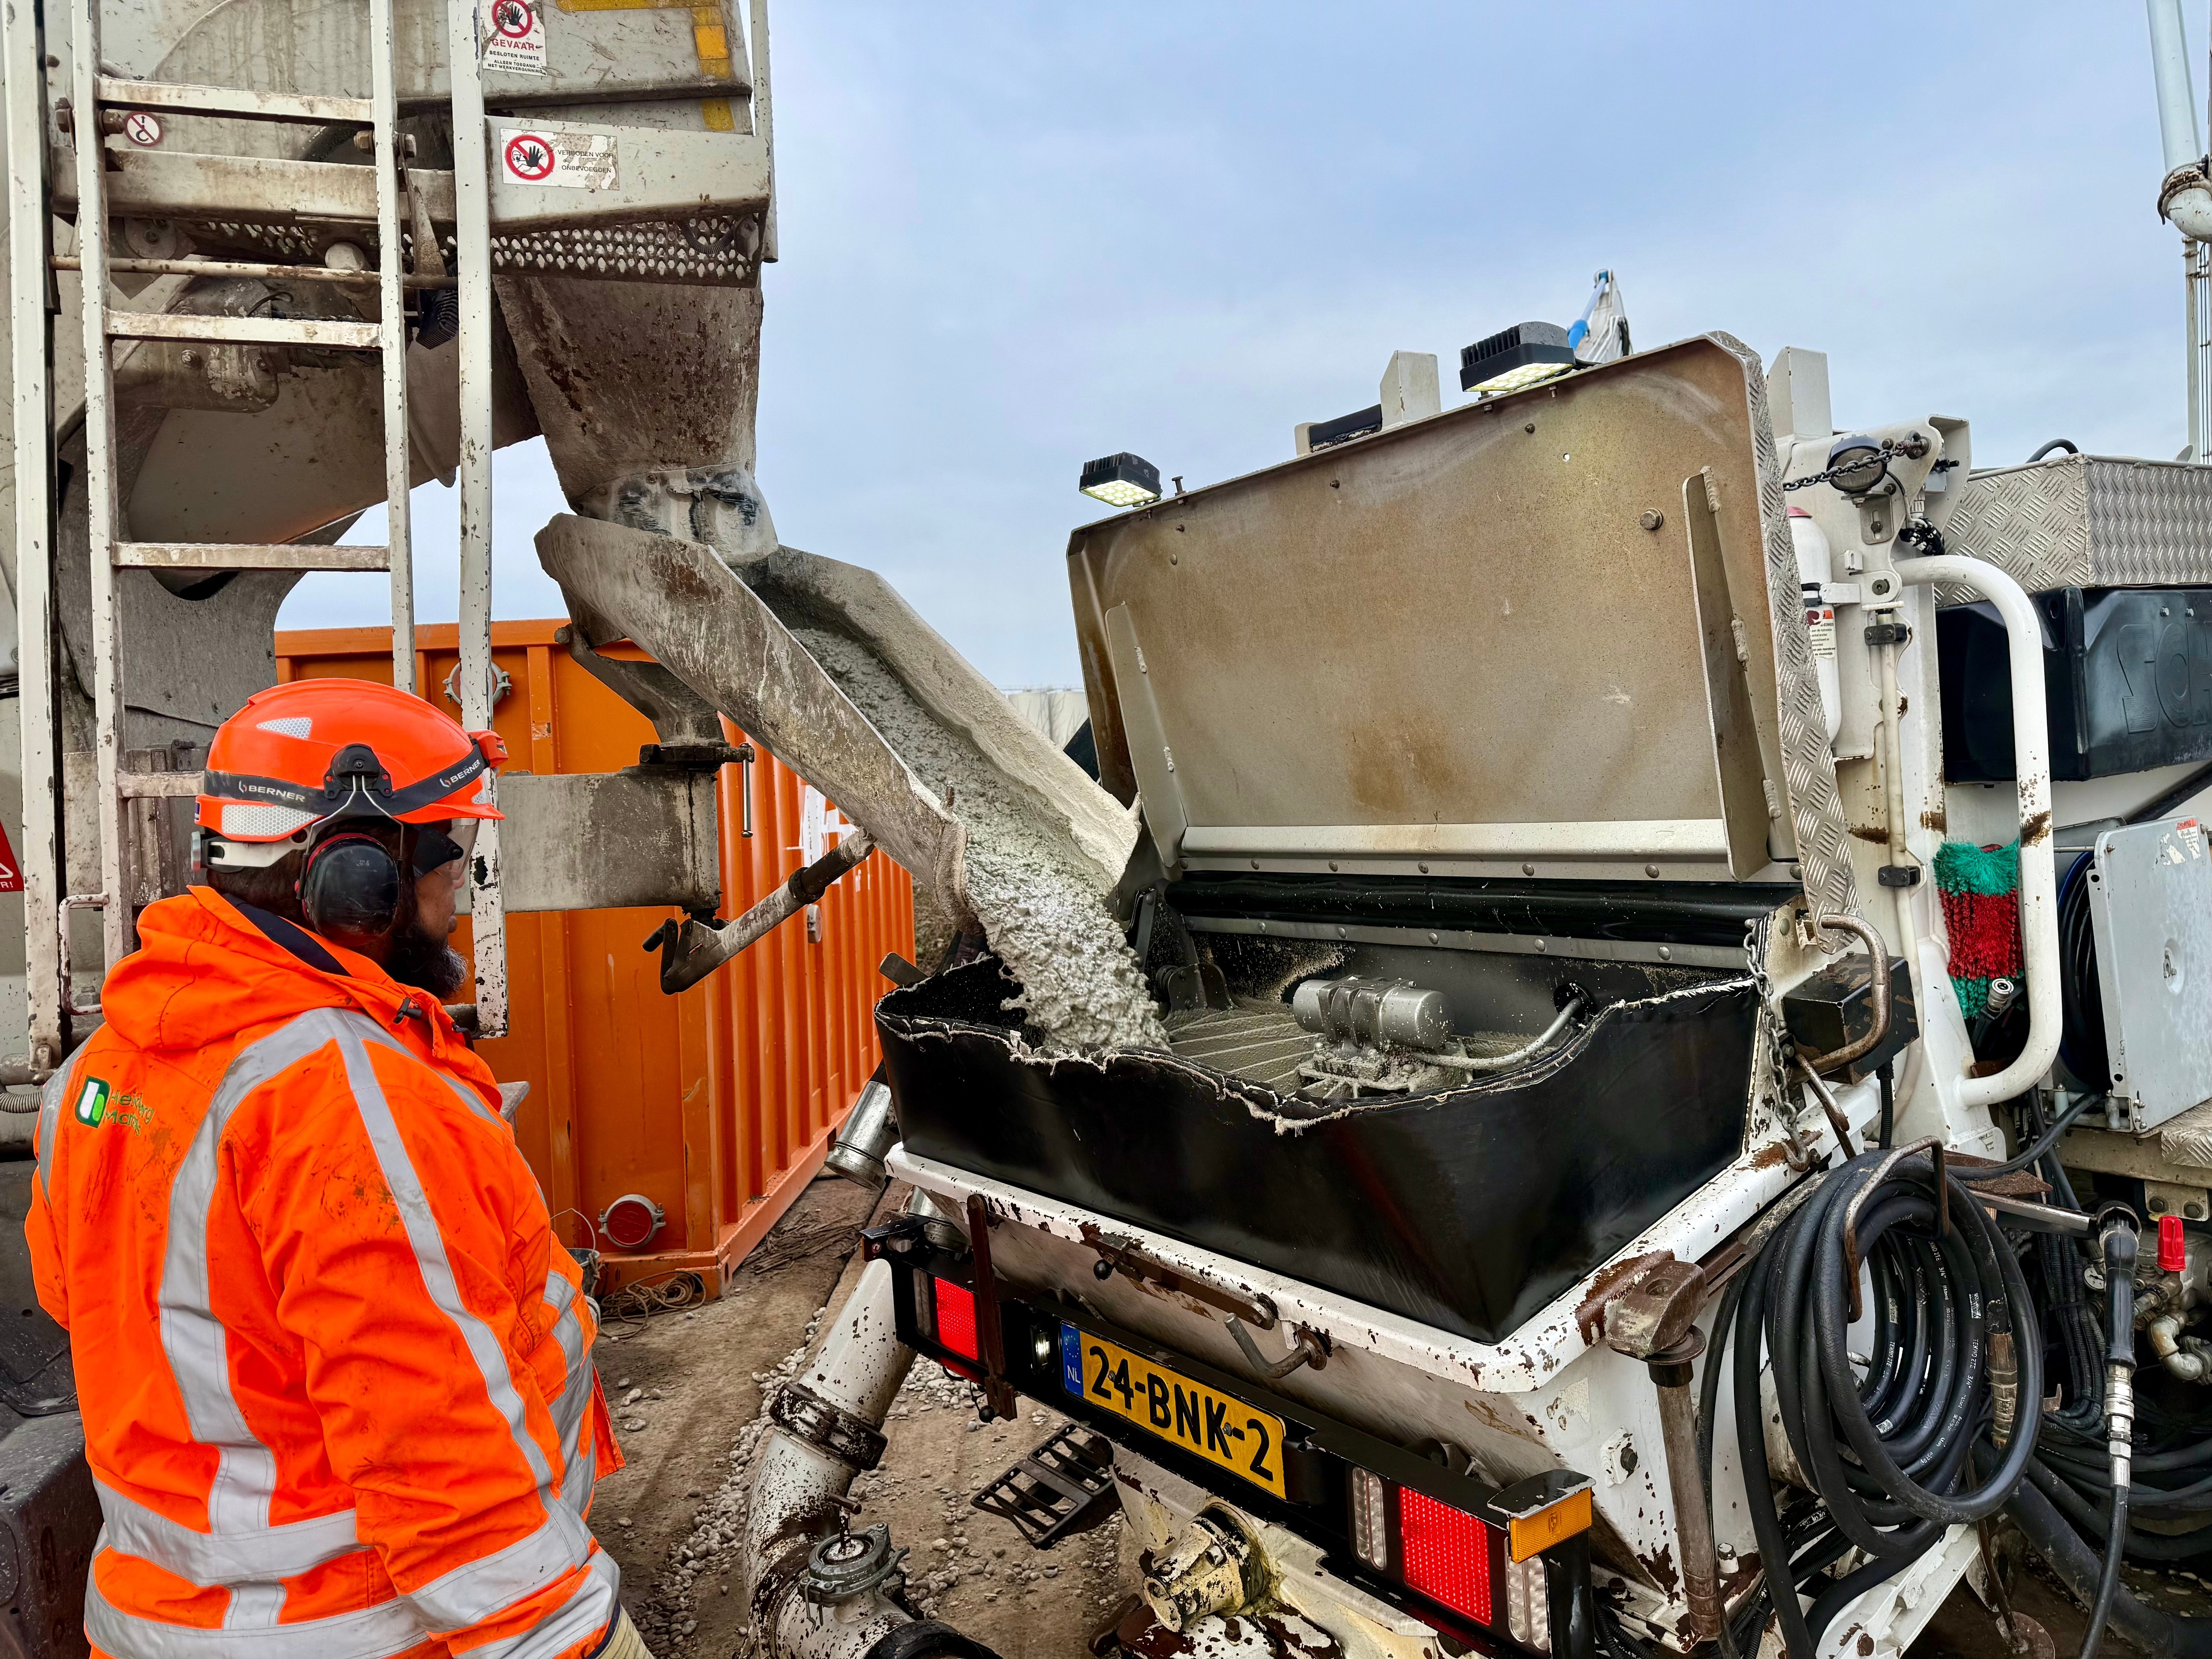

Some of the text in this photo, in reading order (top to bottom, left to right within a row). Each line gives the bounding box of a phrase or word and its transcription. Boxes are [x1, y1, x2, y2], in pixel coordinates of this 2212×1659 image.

[491, 38, 535, 51] GEVAAR
[450, 759, 481, 783] BERNER
[248, 785, 305, 802] BERNER
[1067, 1365, 1081, 1384] NL
[1089, 1345, 1274, 1482] 24-BNK-2
